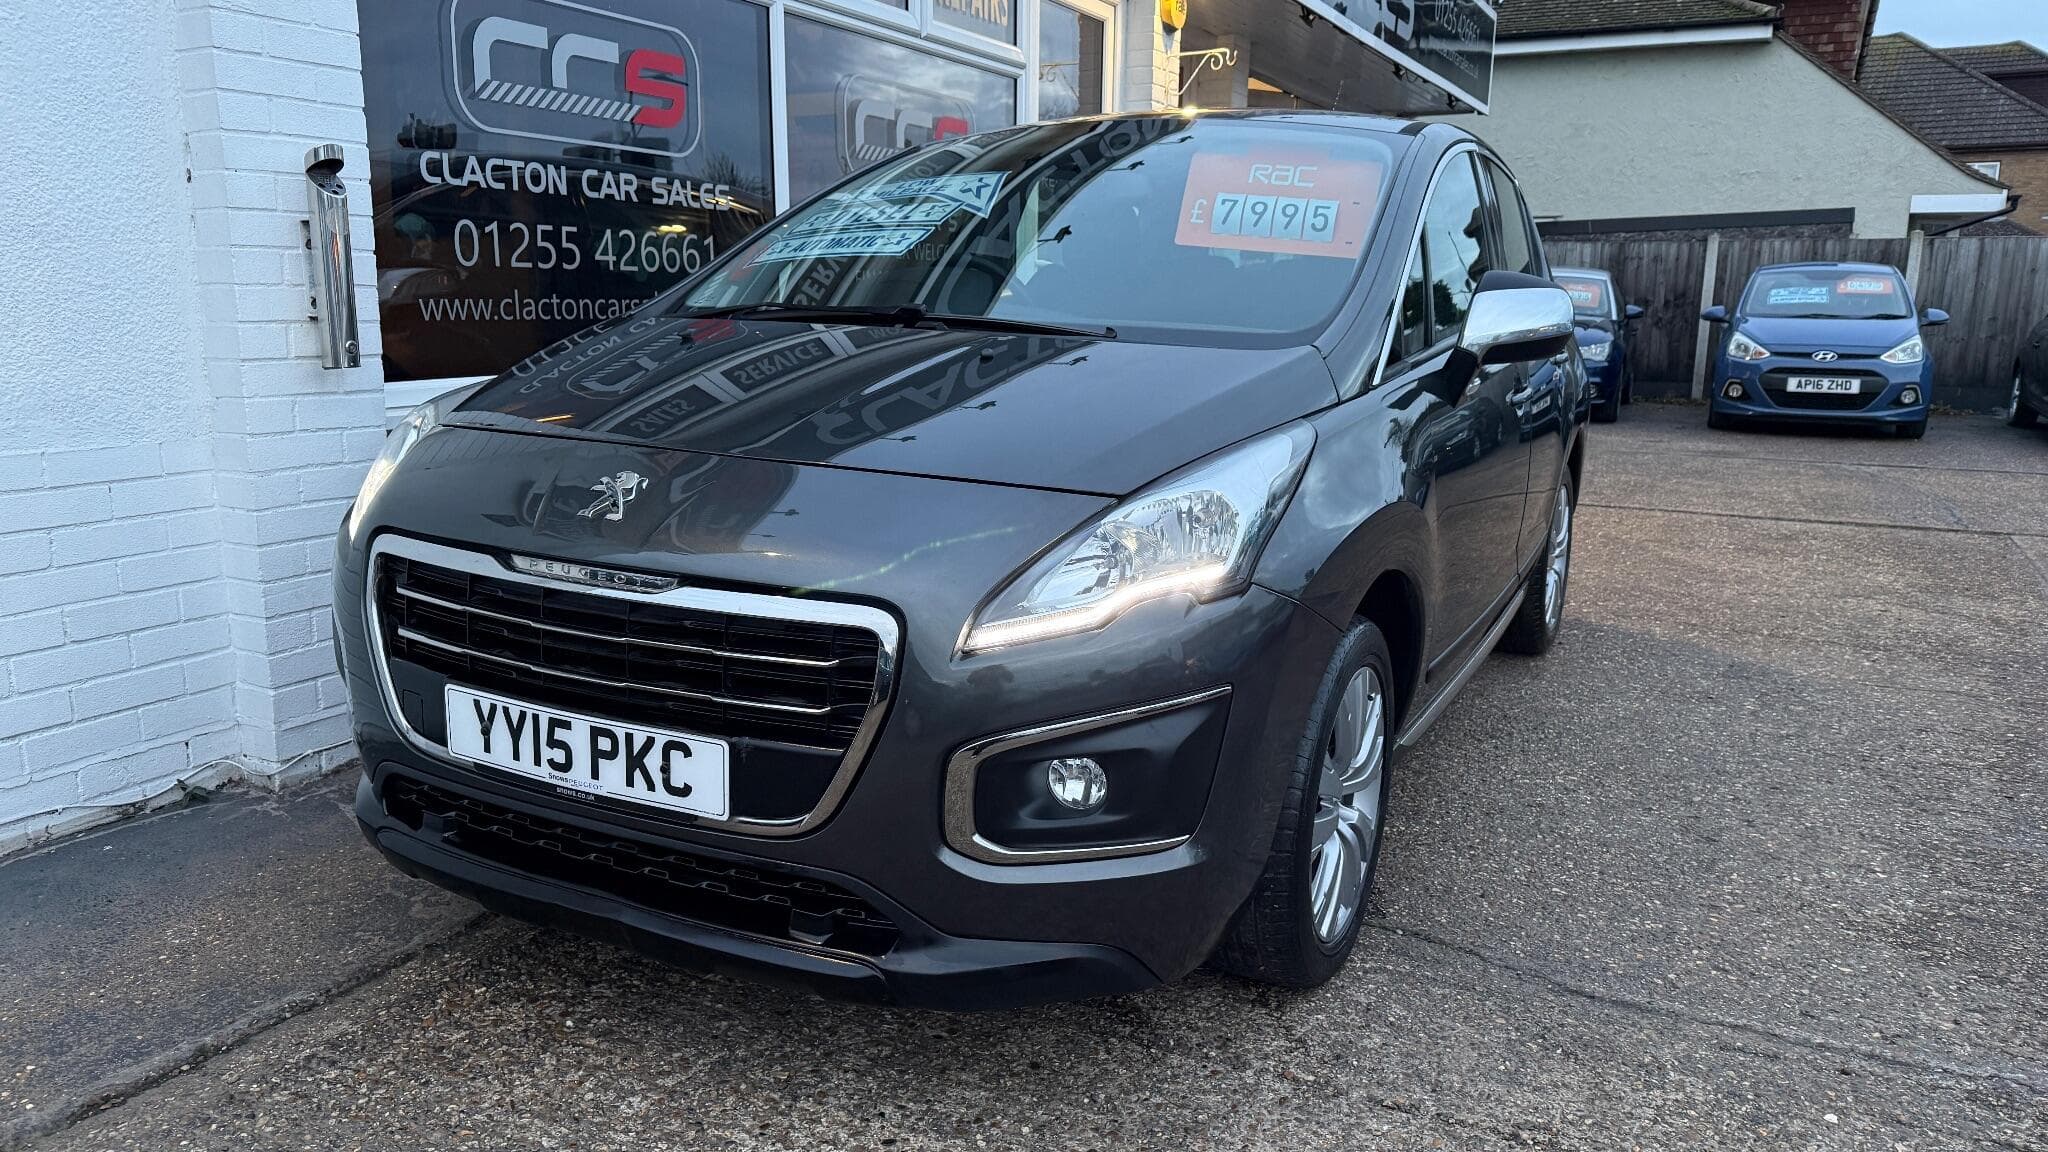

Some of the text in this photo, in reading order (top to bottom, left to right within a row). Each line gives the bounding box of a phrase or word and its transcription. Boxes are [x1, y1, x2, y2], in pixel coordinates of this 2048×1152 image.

[419, 150, 731, 211] CLACTON CAR SALES
[453, 218, 716, 274] 01255 426661
[789, 234, 885, 253] AUTOMATIC
[1796, 378, 1852, 391] AP16 ZHD
[529, 558, 643, 587] PEUGEOT
[473, 697, 693, 799] YY15 PKC
